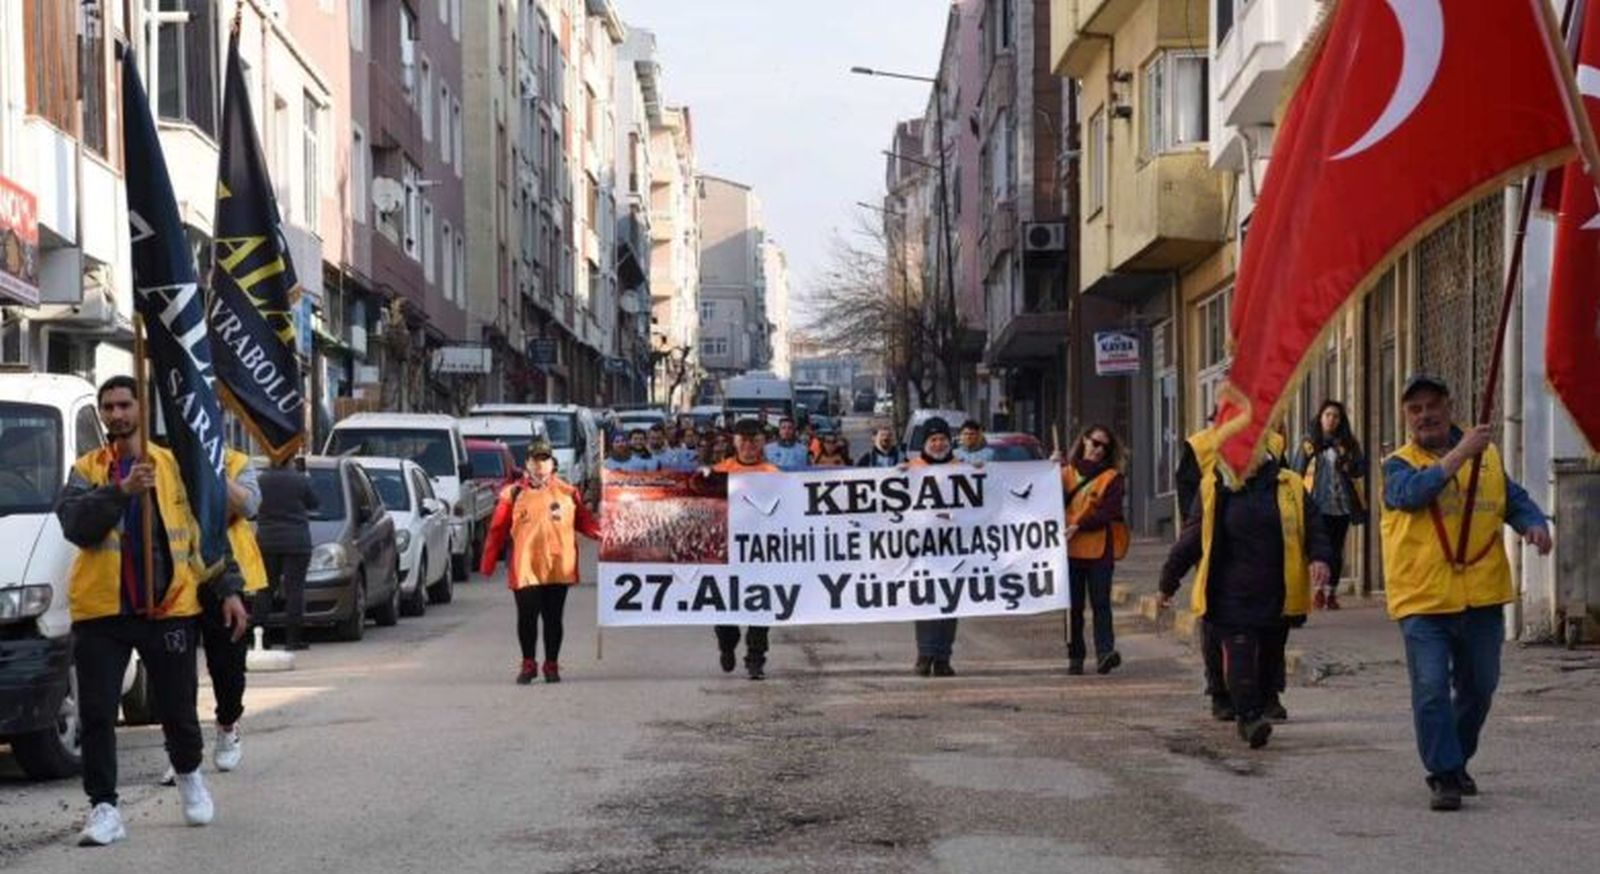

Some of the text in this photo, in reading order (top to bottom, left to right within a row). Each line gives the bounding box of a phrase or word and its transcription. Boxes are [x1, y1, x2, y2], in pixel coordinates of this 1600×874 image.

[804, 474, 987, 523] KEŞAN
[735, 520, 1060, 563] TARİHİ İLE KUCAKLAŞIYOR
[818, 562, 1055, 614] Yürüyüşü
